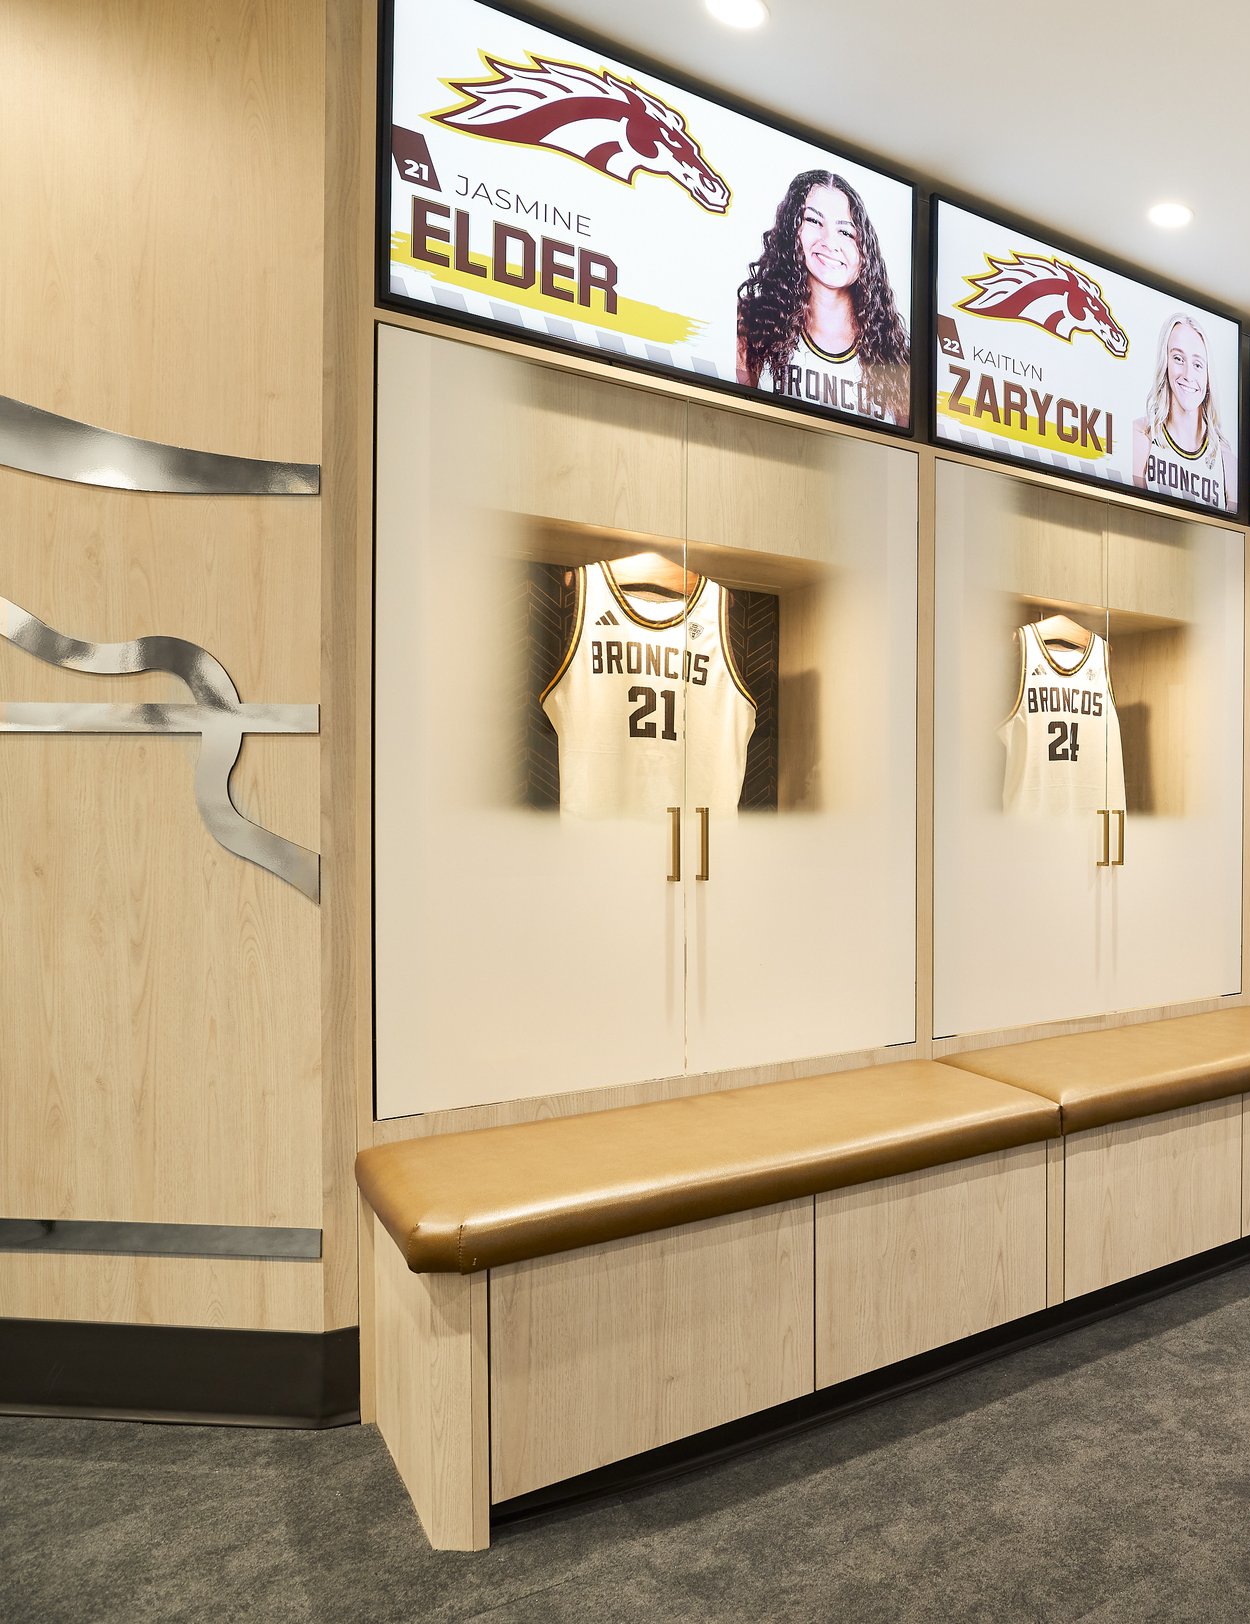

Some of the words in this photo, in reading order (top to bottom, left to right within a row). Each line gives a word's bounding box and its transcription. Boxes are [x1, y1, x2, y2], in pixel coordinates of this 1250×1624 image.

[404, 159, 429, 182] 21
[455, 174, 592, 237] JASMINE
[411, 195, 618, 315] ELDER
[942, 335, 961, 354] 22
[972, 345, 1043, 382] KAITLYN
[948, 363, 1113, 455] ZARYCKI
[1147, 454, 1220, 508] BRONCOS
[592, 641, 710, 686] BRONCOS
[627, 686, 678, 741] 21
[1028, 686, 1103, 717] BRONCOS
